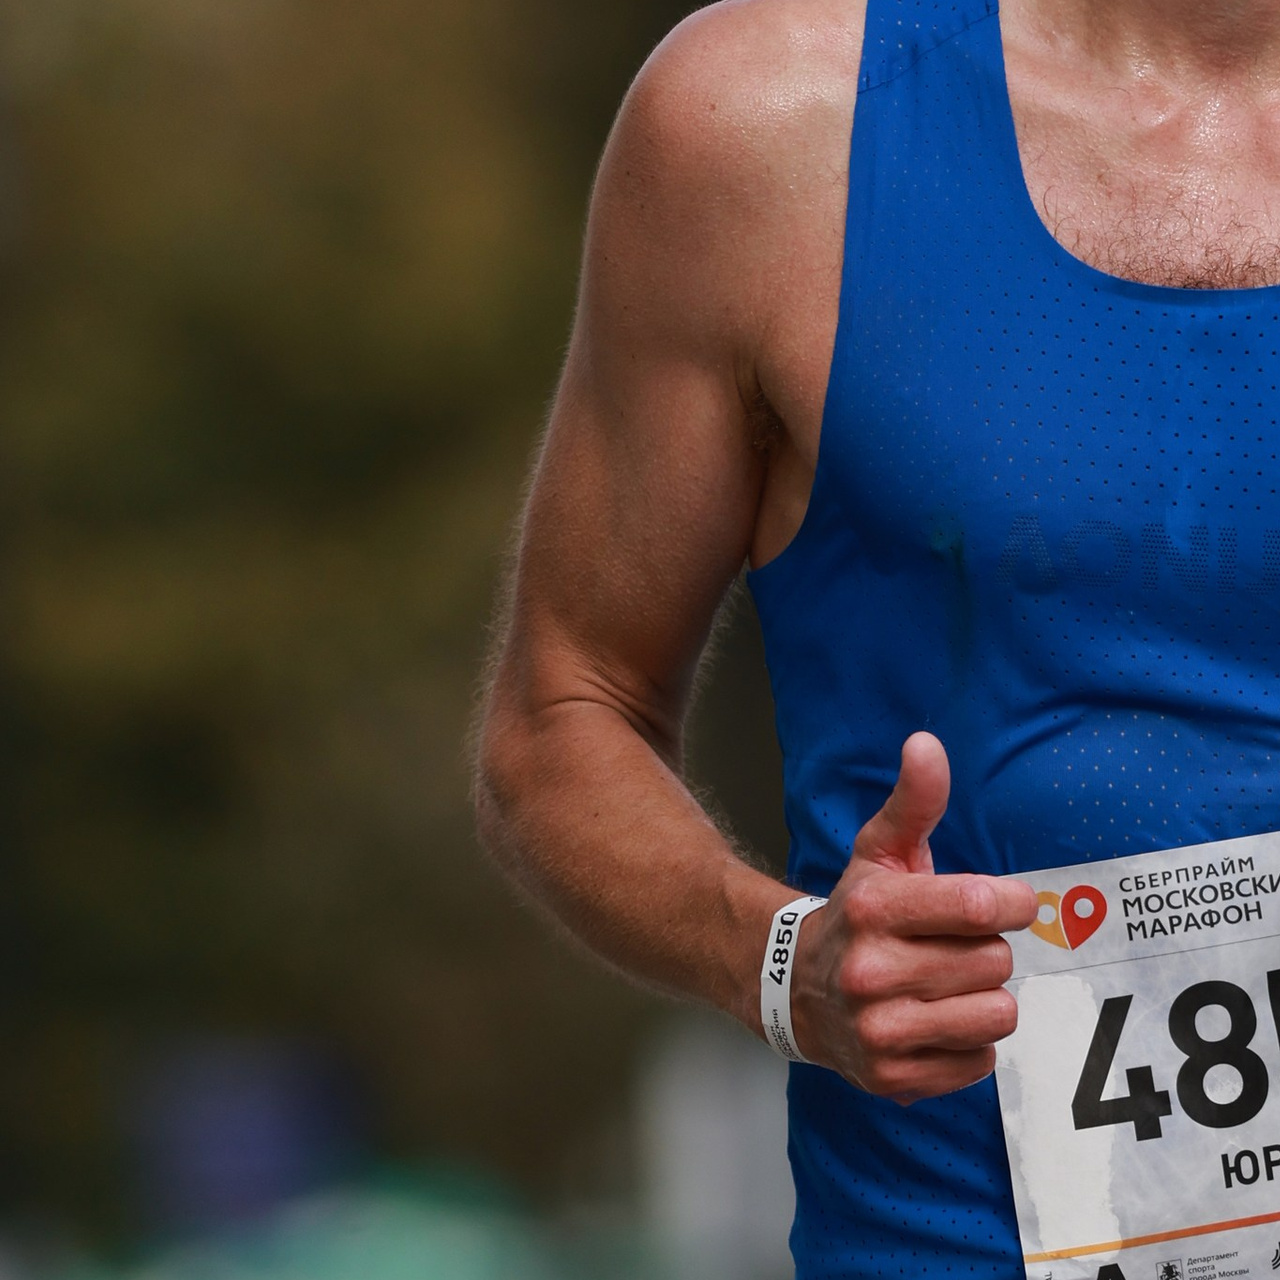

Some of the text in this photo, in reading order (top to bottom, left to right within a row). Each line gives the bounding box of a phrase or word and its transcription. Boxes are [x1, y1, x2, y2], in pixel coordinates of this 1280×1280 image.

[1119, 856, 1255, 893] СБЕРПРАЙМ
[1126, 901, 1263, 941] МАРАФОН
[769, 912, 799, 986] 4850
[1187, 1251, 1239, 1266] Департамент
[1188, 1264, 1215, 1274] спорта
[1218, 1268, 1250, 1279] Москвы
